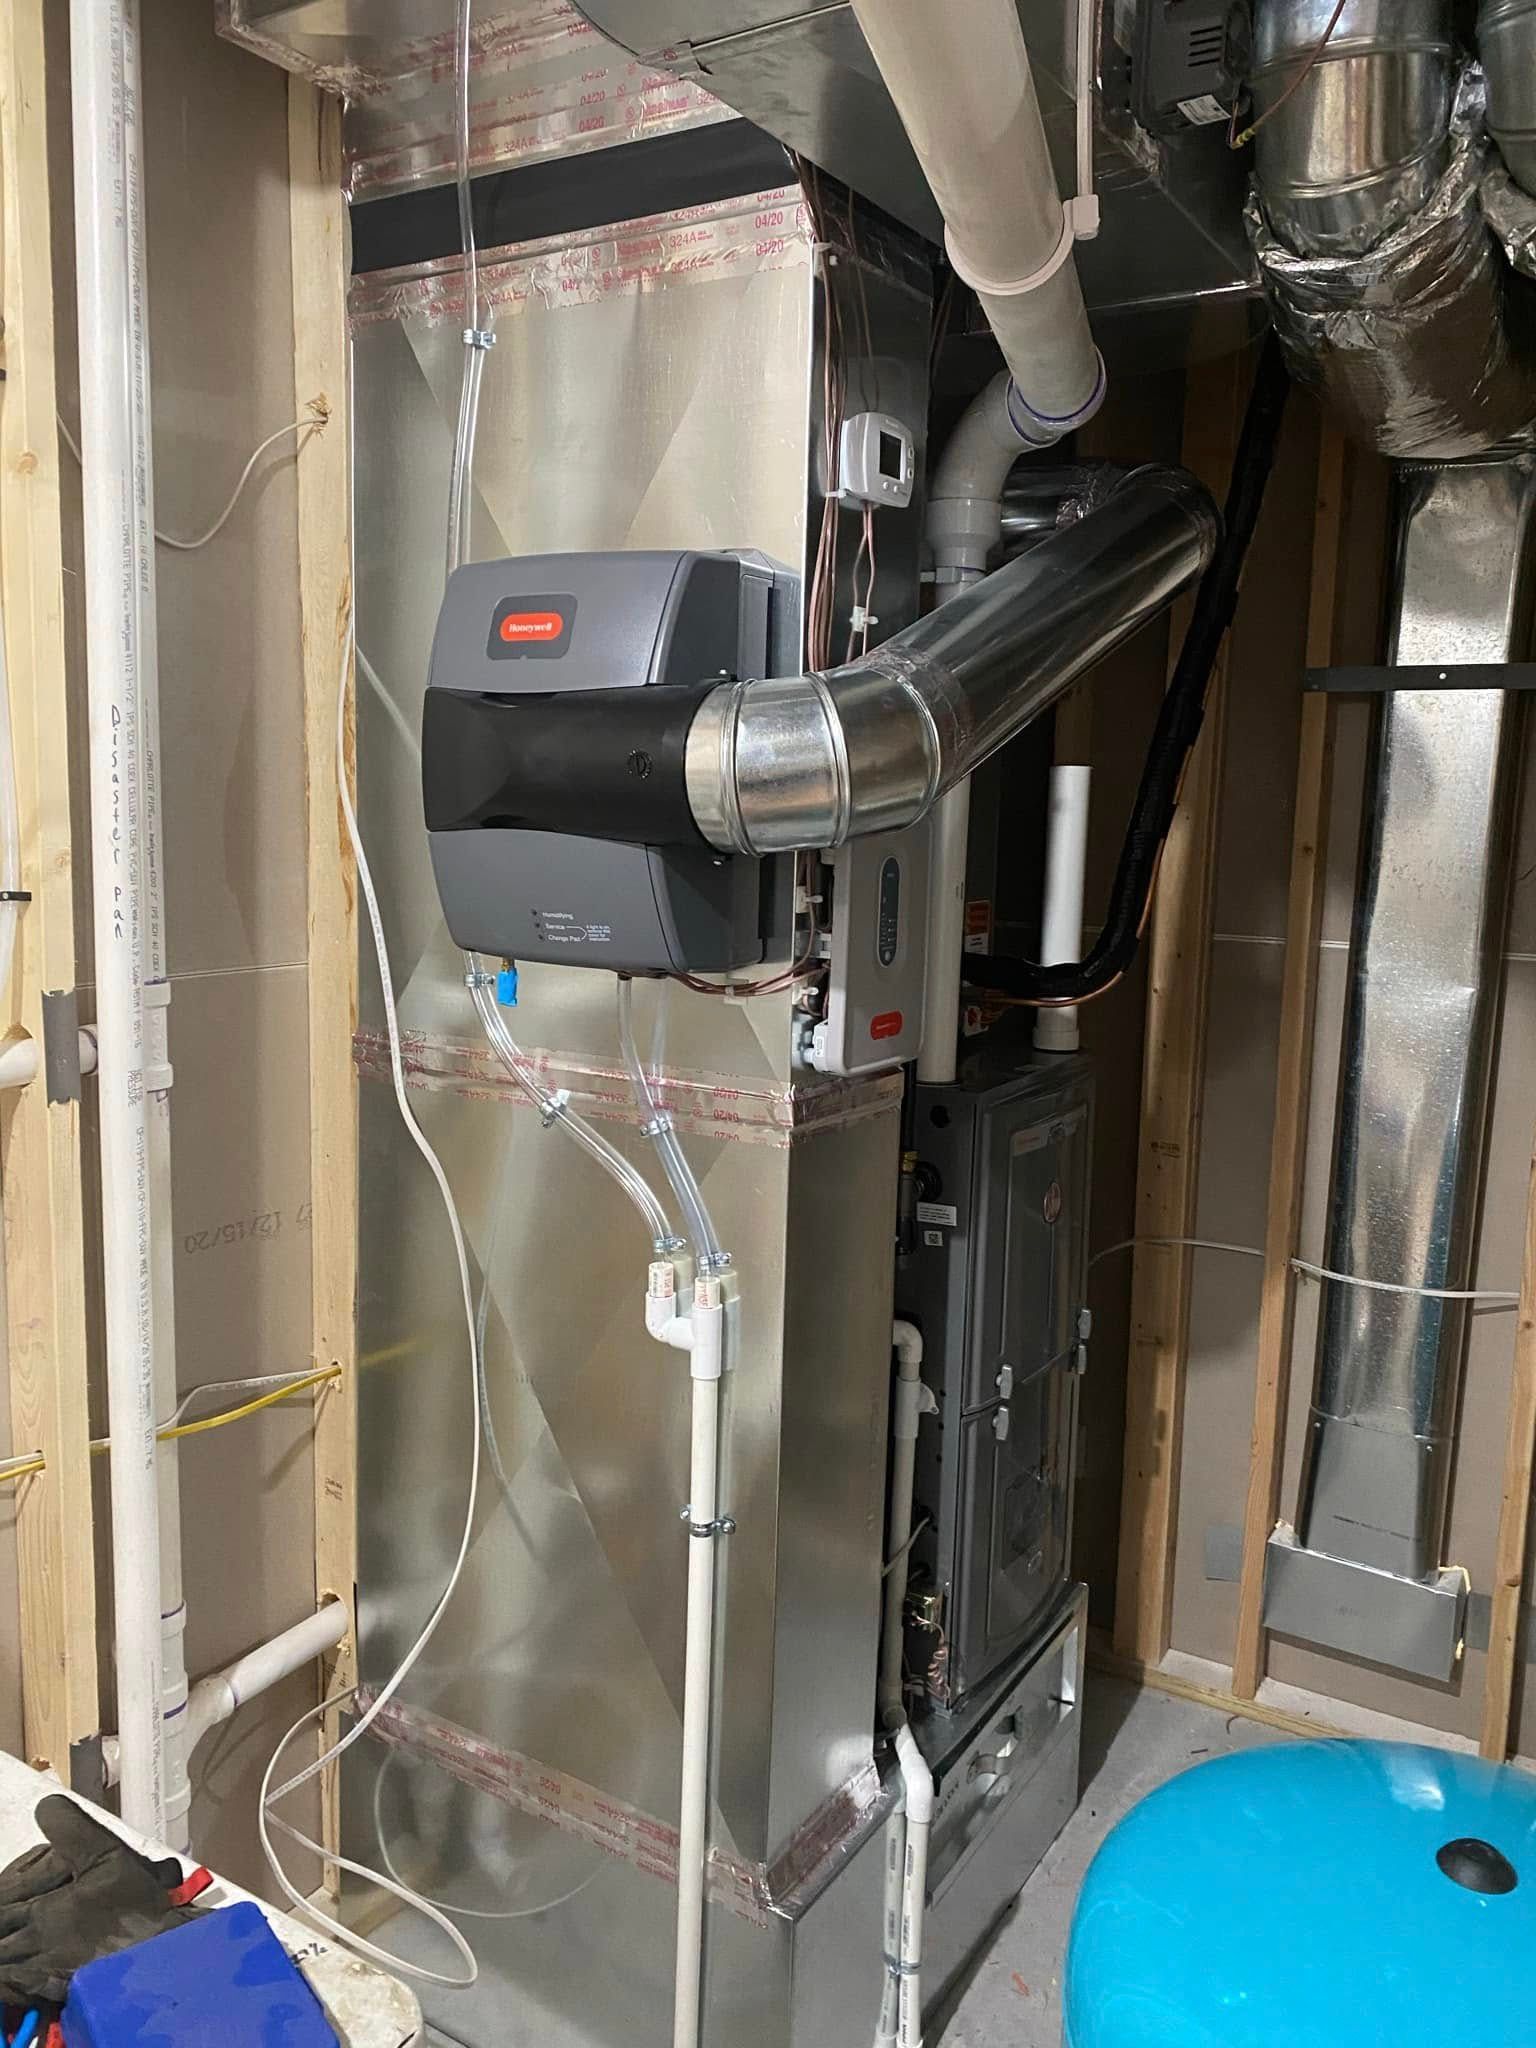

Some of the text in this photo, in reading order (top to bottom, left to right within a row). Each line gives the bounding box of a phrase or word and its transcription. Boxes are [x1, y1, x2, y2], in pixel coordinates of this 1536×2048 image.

[754, 211, 784, 228] 04/20
[508, 621, 553, 633] Honeywell
[146, 750, 156, 792] CHARLOTTE
[111, 704, 125, 939] Disaster pan
[147, 796, 156, 816] PIPE
[183, 1210, 281, 1255] 12/15/20
